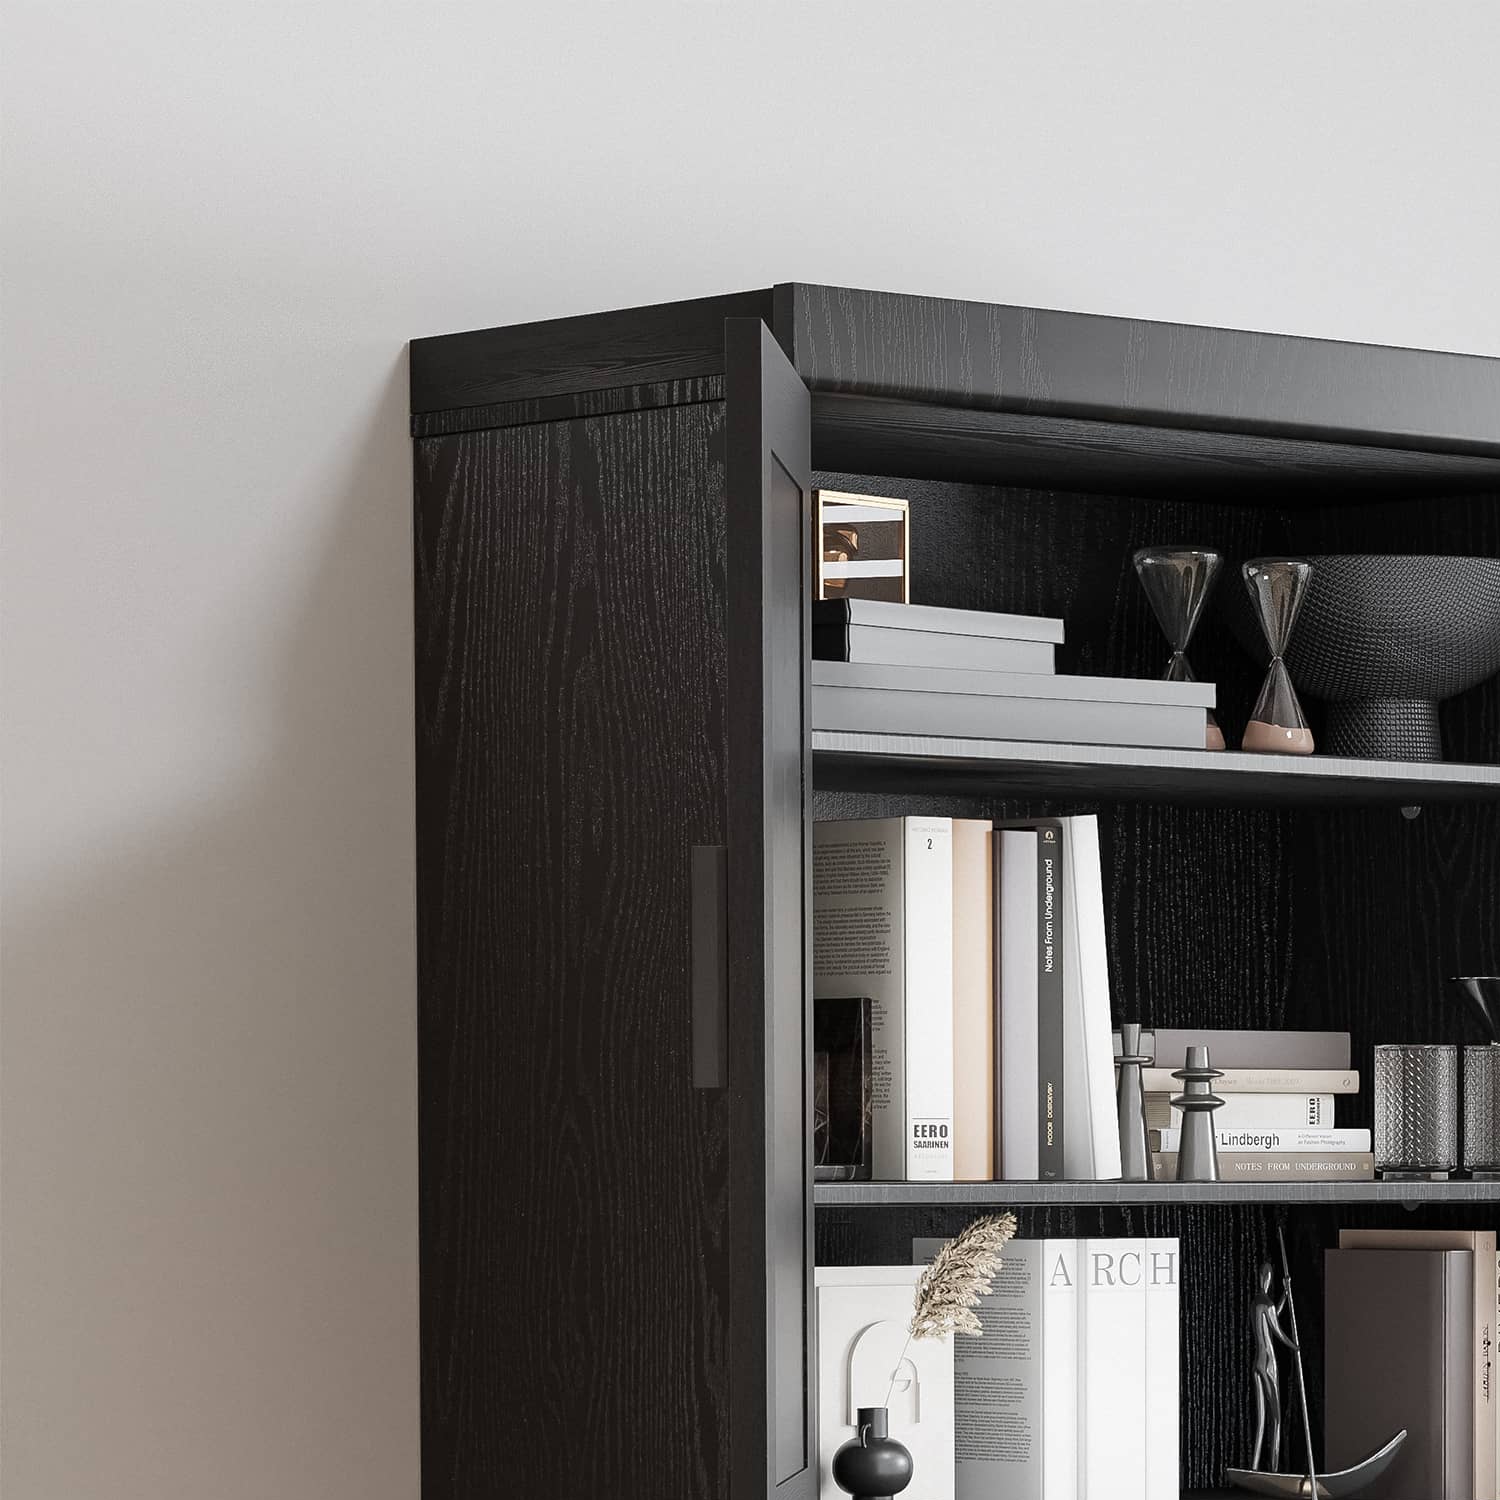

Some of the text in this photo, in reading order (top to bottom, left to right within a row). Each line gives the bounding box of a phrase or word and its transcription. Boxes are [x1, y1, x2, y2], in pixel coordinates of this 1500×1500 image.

[927, 838, 933, 850] 2
[1044, 859, 1054, 972] Notes From Underground
[913, 1124, 948, 1138] EERO
[913, 1140, 949, 1149] SAARINEN
[1221, 1133, 1280, 1149] Lindbergh
[1235, 1162, 1356, 1171] NOTES FROM UNDERGROUND
